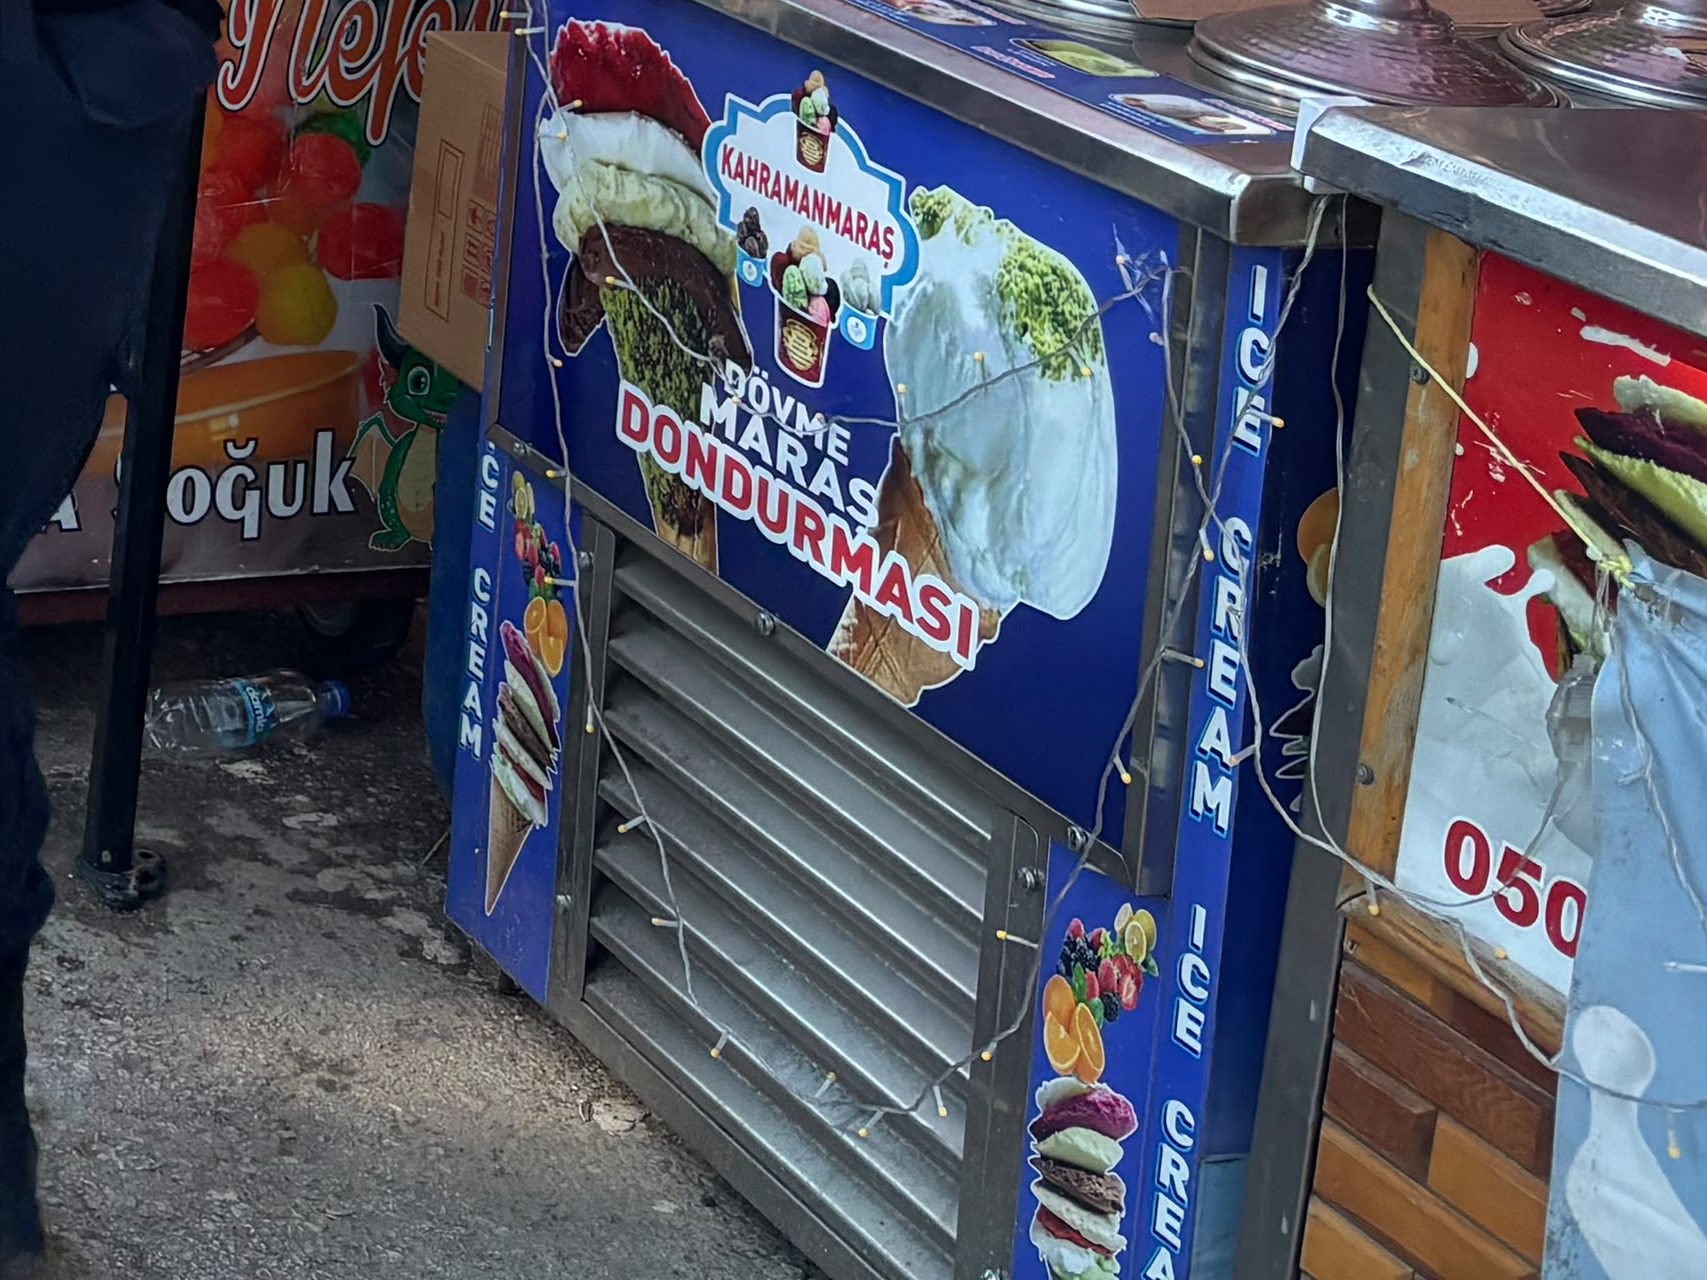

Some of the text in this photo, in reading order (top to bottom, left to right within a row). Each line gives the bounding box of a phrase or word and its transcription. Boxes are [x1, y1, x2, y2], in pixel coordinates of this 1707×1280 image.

[720, 142, 895, 276] KAHRAMANMARAŞ
[166, 430, 356, 539] oğuk
[621, 386, 975, 664] DONDURMASI
[724, 358, 851, 467] DÖVME
[1188, 263, 1271, 838] ICE CREAM
[459, 443, 501, 760] CE CREAM
[1143, 903, 1211, 1280] ICE CREA
